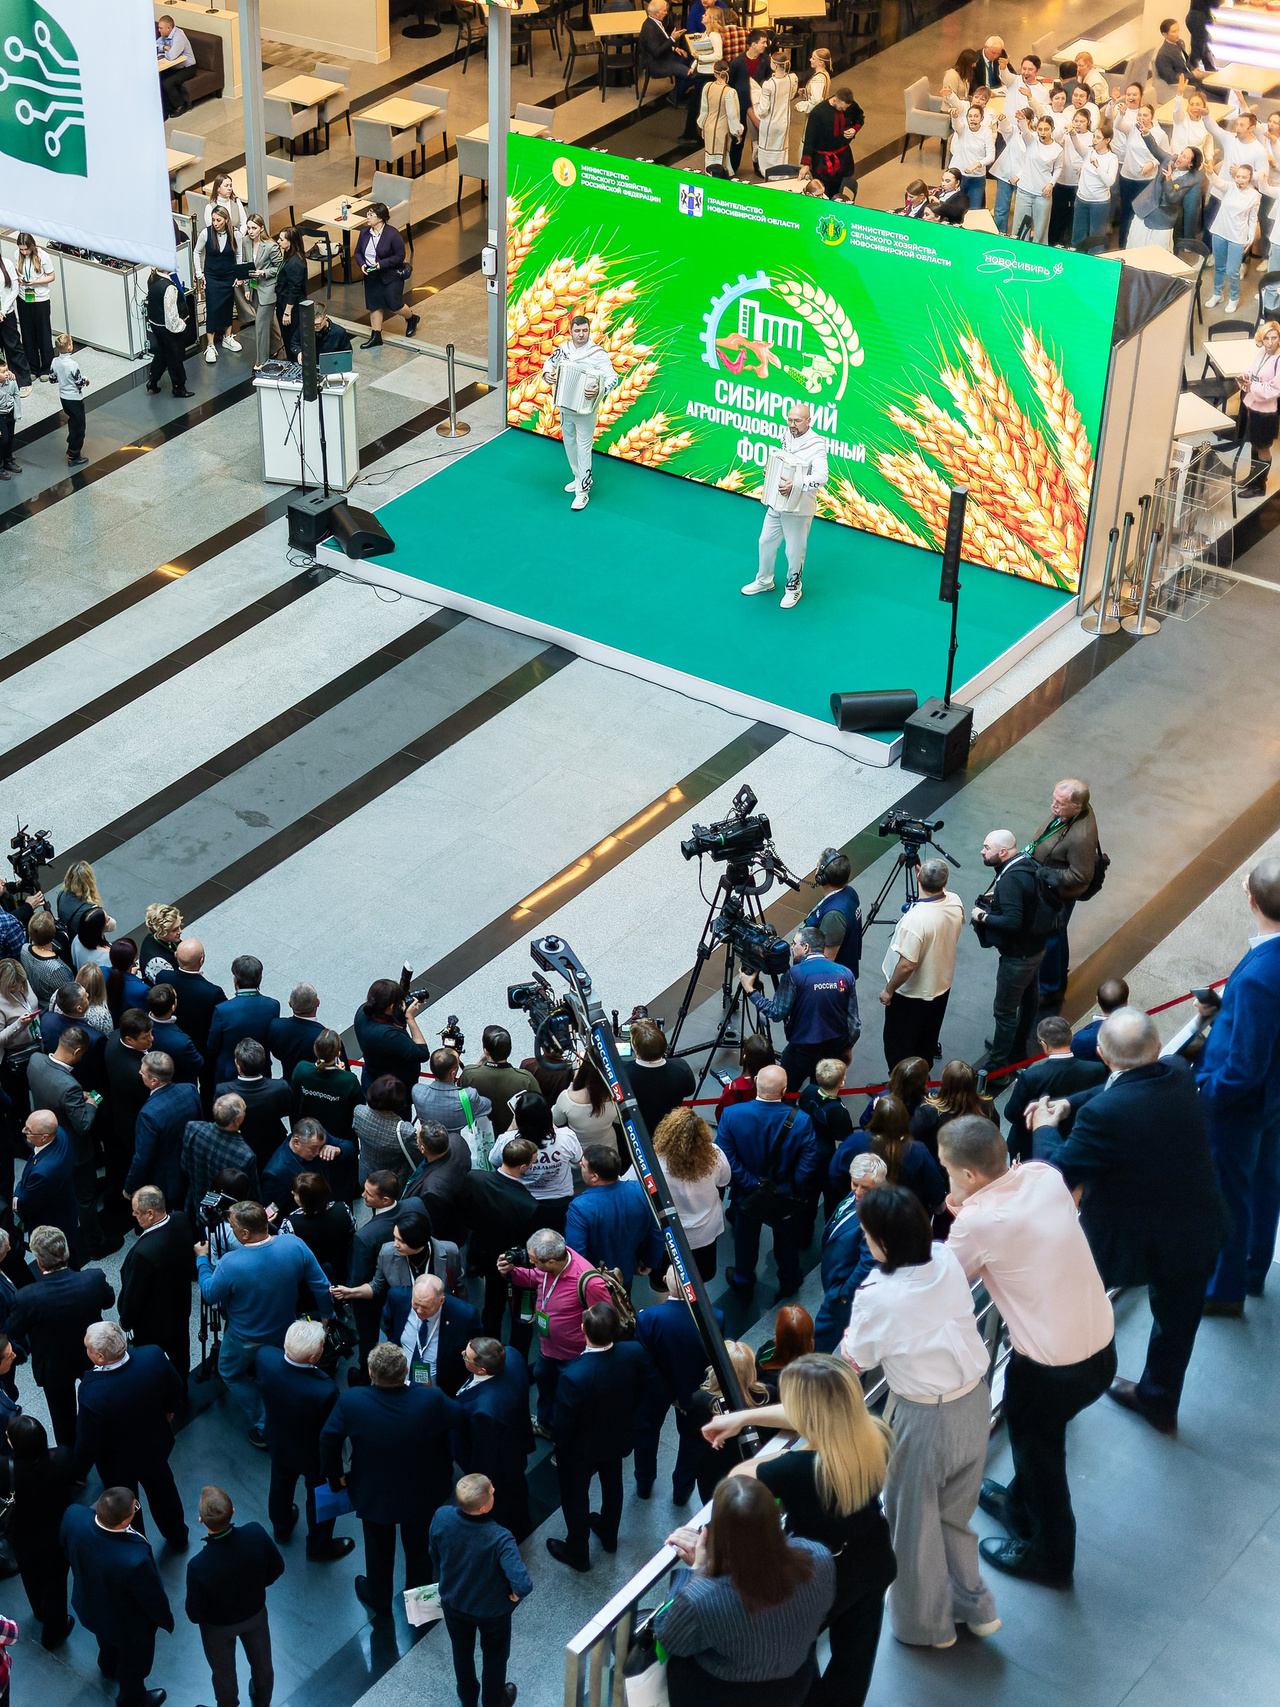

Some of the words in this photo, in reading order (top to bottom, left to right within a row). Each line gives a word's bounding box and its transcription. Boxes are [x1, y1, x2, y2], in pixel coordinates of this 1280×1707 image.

[581, 164, 630, 181] МИНИСТЕРСТВО
[581, 172, 616, 186] СЕЛЬСКОГО
[616, 179, 653, 194] ХОЗЯЙСТВА
[581, 179, 622, 195] РОССИЙСКОЙ
[622, 188, 662, 204] ФЕДЕРАЦИИ
[707, 197, 764, 214] ПРАВИТЕЛЬСТВО
[707, 205, 767, 223] НОВОСИБИРСКОЙ
[767, 216, 800, 230] ОБЛАСТИ
[850, 230, 893, 246] СЕЛЬСКОГО
[893, 239, 937, 256] ХОЗЯЙСТВА
[851, 222, 910, 241] МИНИСТЕРСТВО
[850, 238, 915, 259] НОВОСИБИРСКОЙ
[916, 253, 952, 267] ОБЛАСТИ
[715, 379, 838, 434] СИБИРСИЙ
[814, 983, 837, 991] РОССИЯ
[594, 1033, 615, 1080] РОССИЯ
[611, 1085, 622, 1101] 24
[627, 1124, 648, 1172] РОССИЯ
[665, 1231, 687, 1282] СИБИРЬ
[684, 1285, 696, 1302] 24
